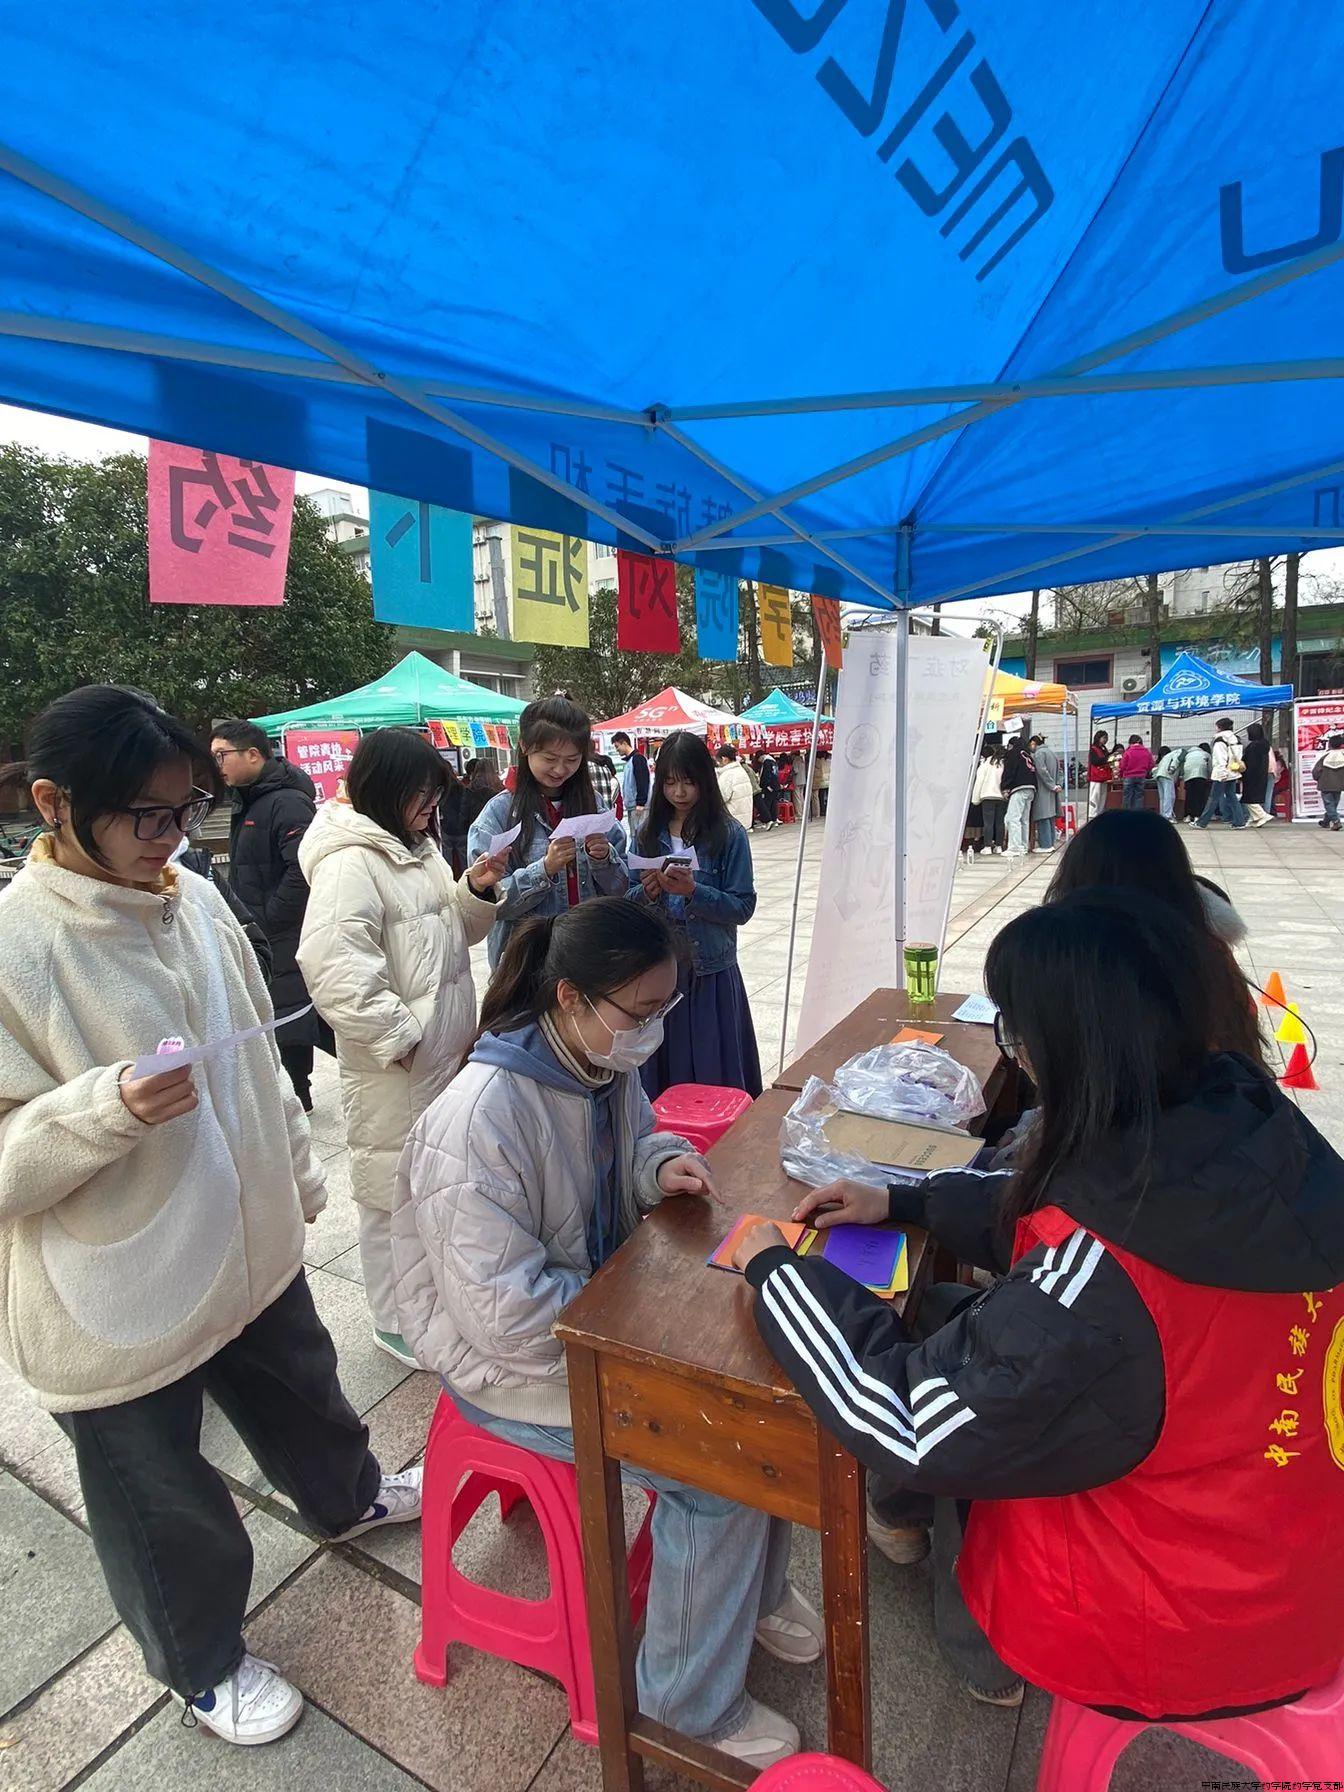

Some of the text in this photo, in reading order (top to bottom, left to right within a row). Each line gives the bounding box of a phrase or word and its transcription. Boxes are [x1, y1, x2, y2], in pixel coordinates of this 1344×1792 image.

[1301, 705, 1344, 715] 学雷锋纪念
